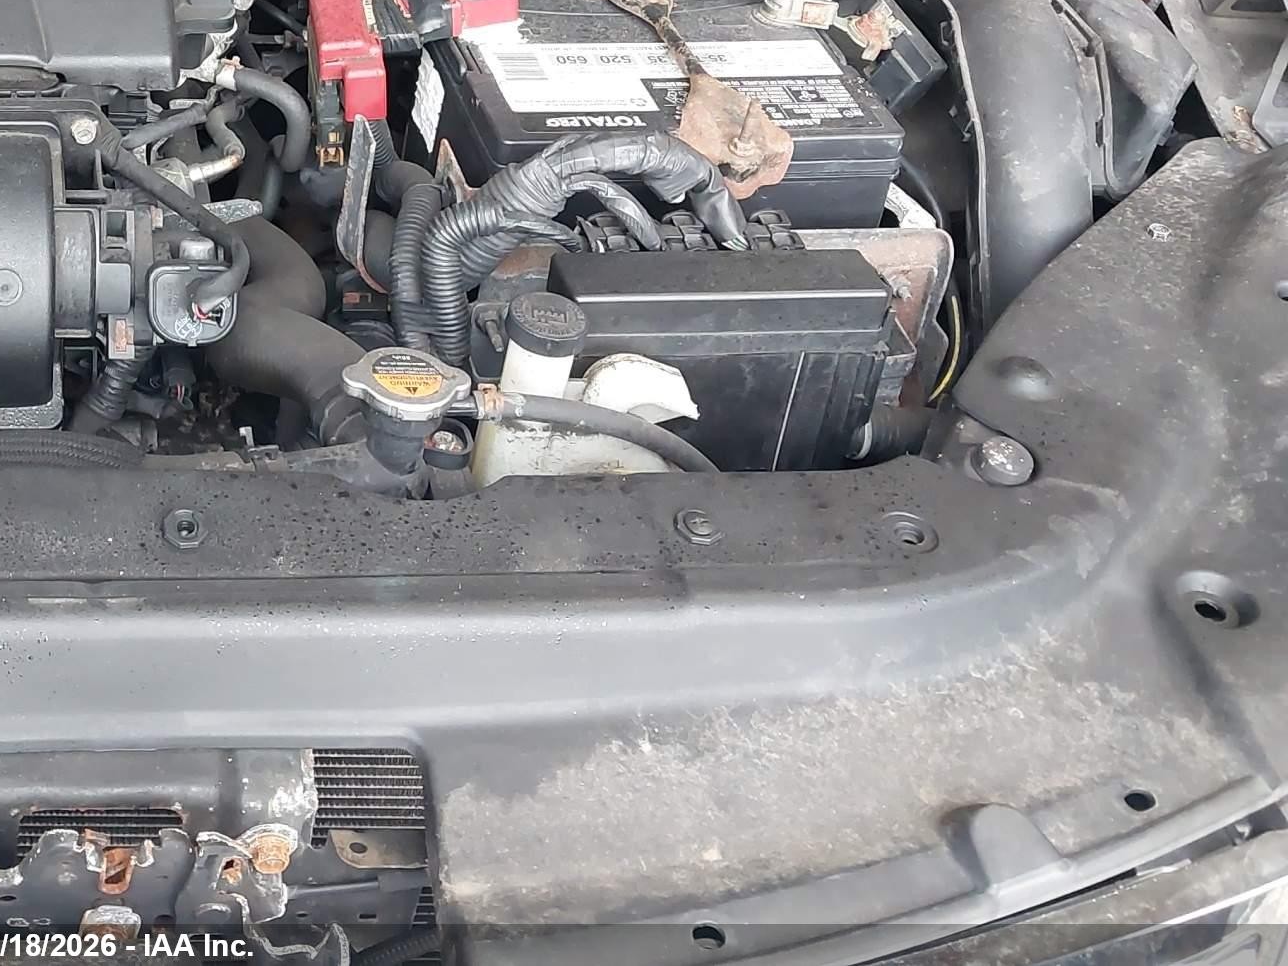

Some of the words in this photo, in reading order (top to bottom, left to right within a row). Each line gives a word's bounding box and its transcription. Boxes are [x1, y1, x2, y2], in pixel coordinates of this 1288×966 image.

[555, 54, 588, 65] 650
[599, 54, 632, 65] 520
[544, 114, 648, 128] TOTALPRO
